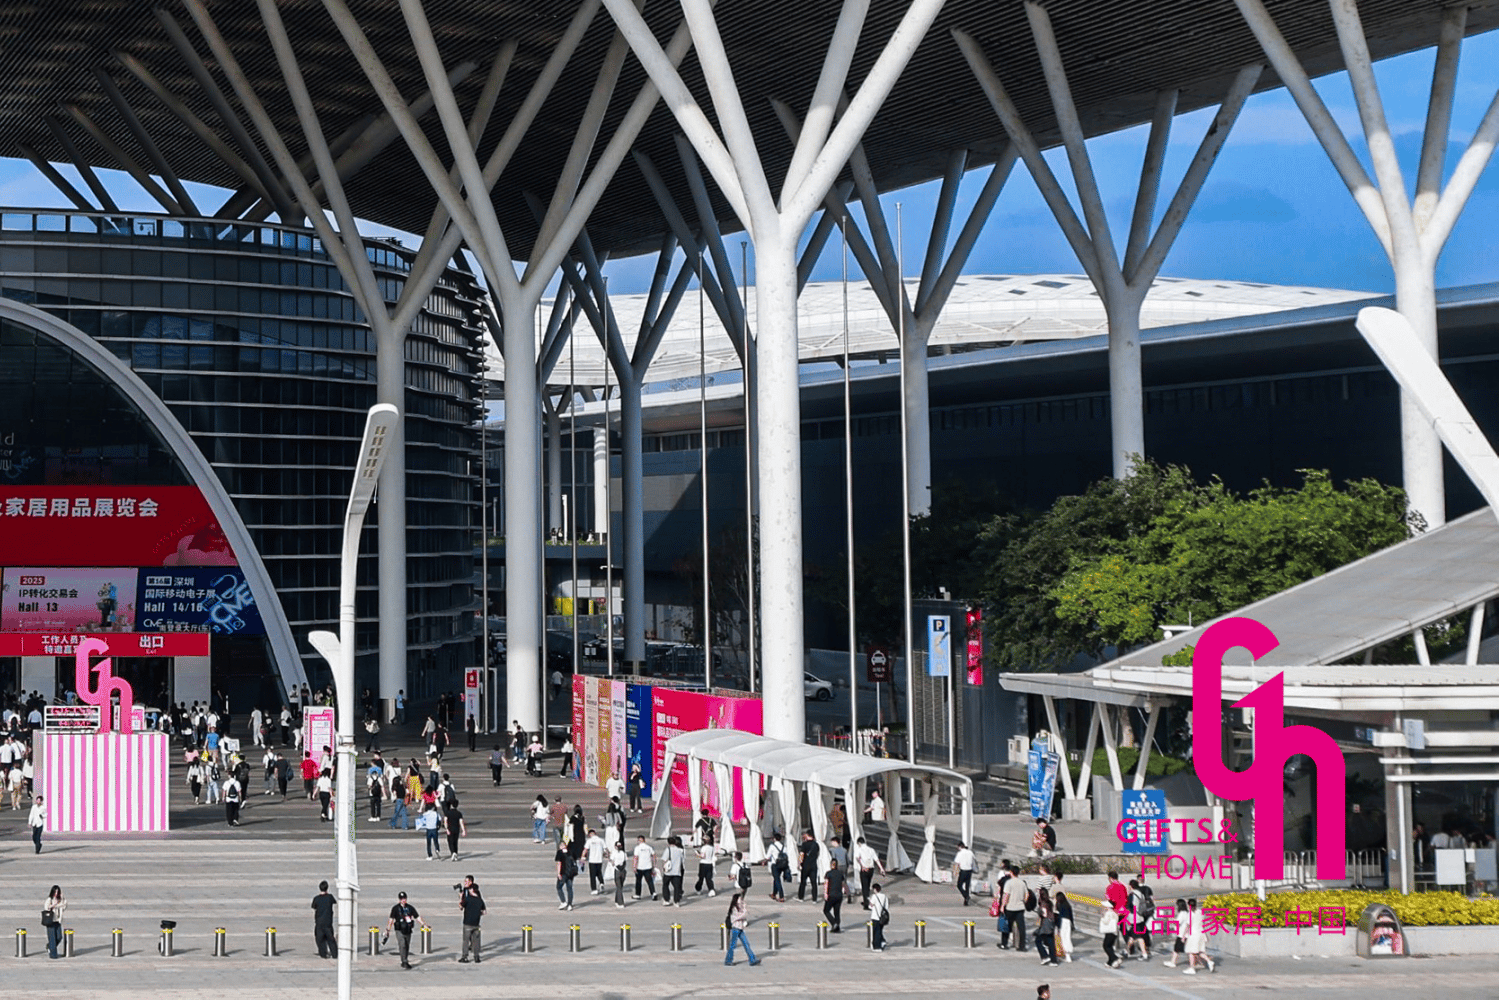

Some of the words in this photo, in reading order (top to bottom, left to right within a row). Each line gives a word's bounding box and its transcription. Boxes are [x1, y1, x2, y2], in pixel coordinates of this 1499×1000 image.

[22, 576, 43, 585] 2025
[173, 577, 195, 586] 深圳
[18, 588, 78, 599] IP转化交易会
[145, 588, 216, 599] 国际移动电子展
[18, 602, 39, 612] Hall
[46, 602, 59, 612] 13
[144, 602, 165, 612] Hall
[935, 620, 943, 630] P
[139, 635, 164, 648] 出口
